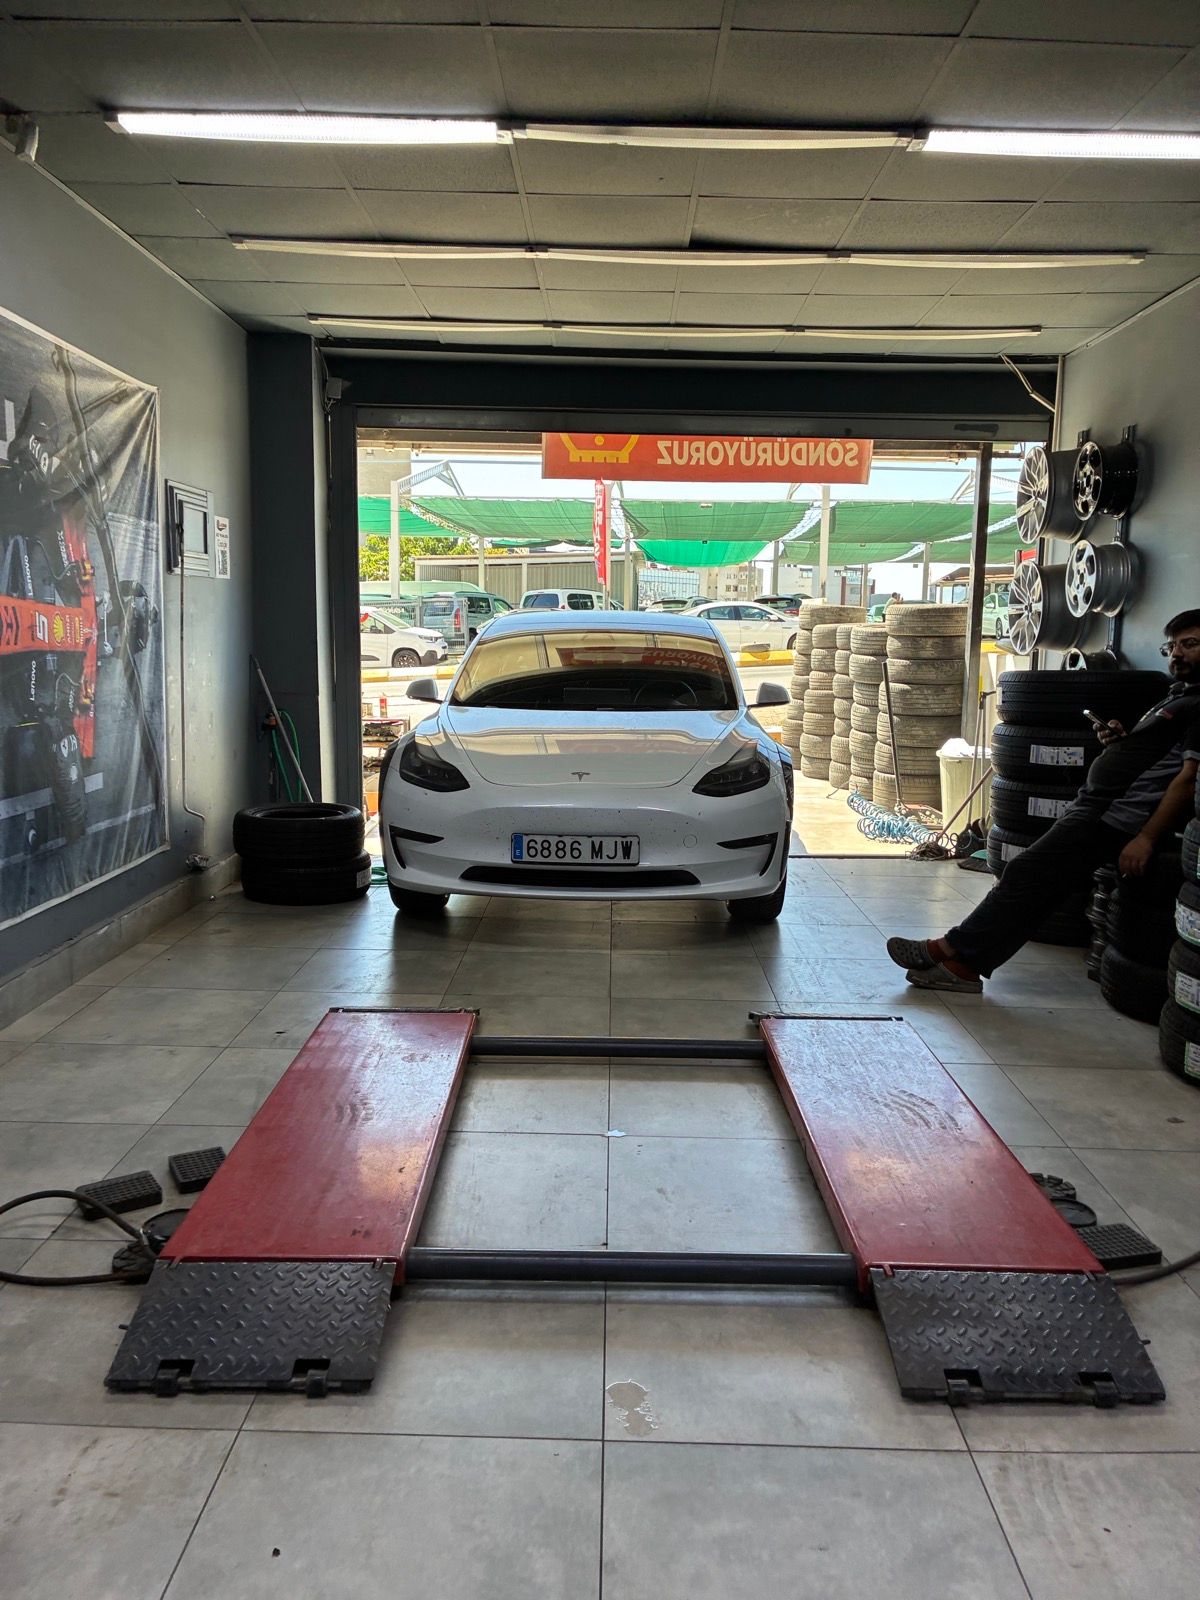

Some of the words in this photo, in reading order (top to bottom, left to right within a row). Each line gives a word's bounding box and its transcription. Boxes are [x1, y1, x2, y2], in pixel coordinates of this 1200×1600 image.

[24, 554, 34, 596] Lenovo
[35, 611, 49, 644] 5
[526, 838, 582, 860] 6886
[590, 840, 633, 860] MJW
